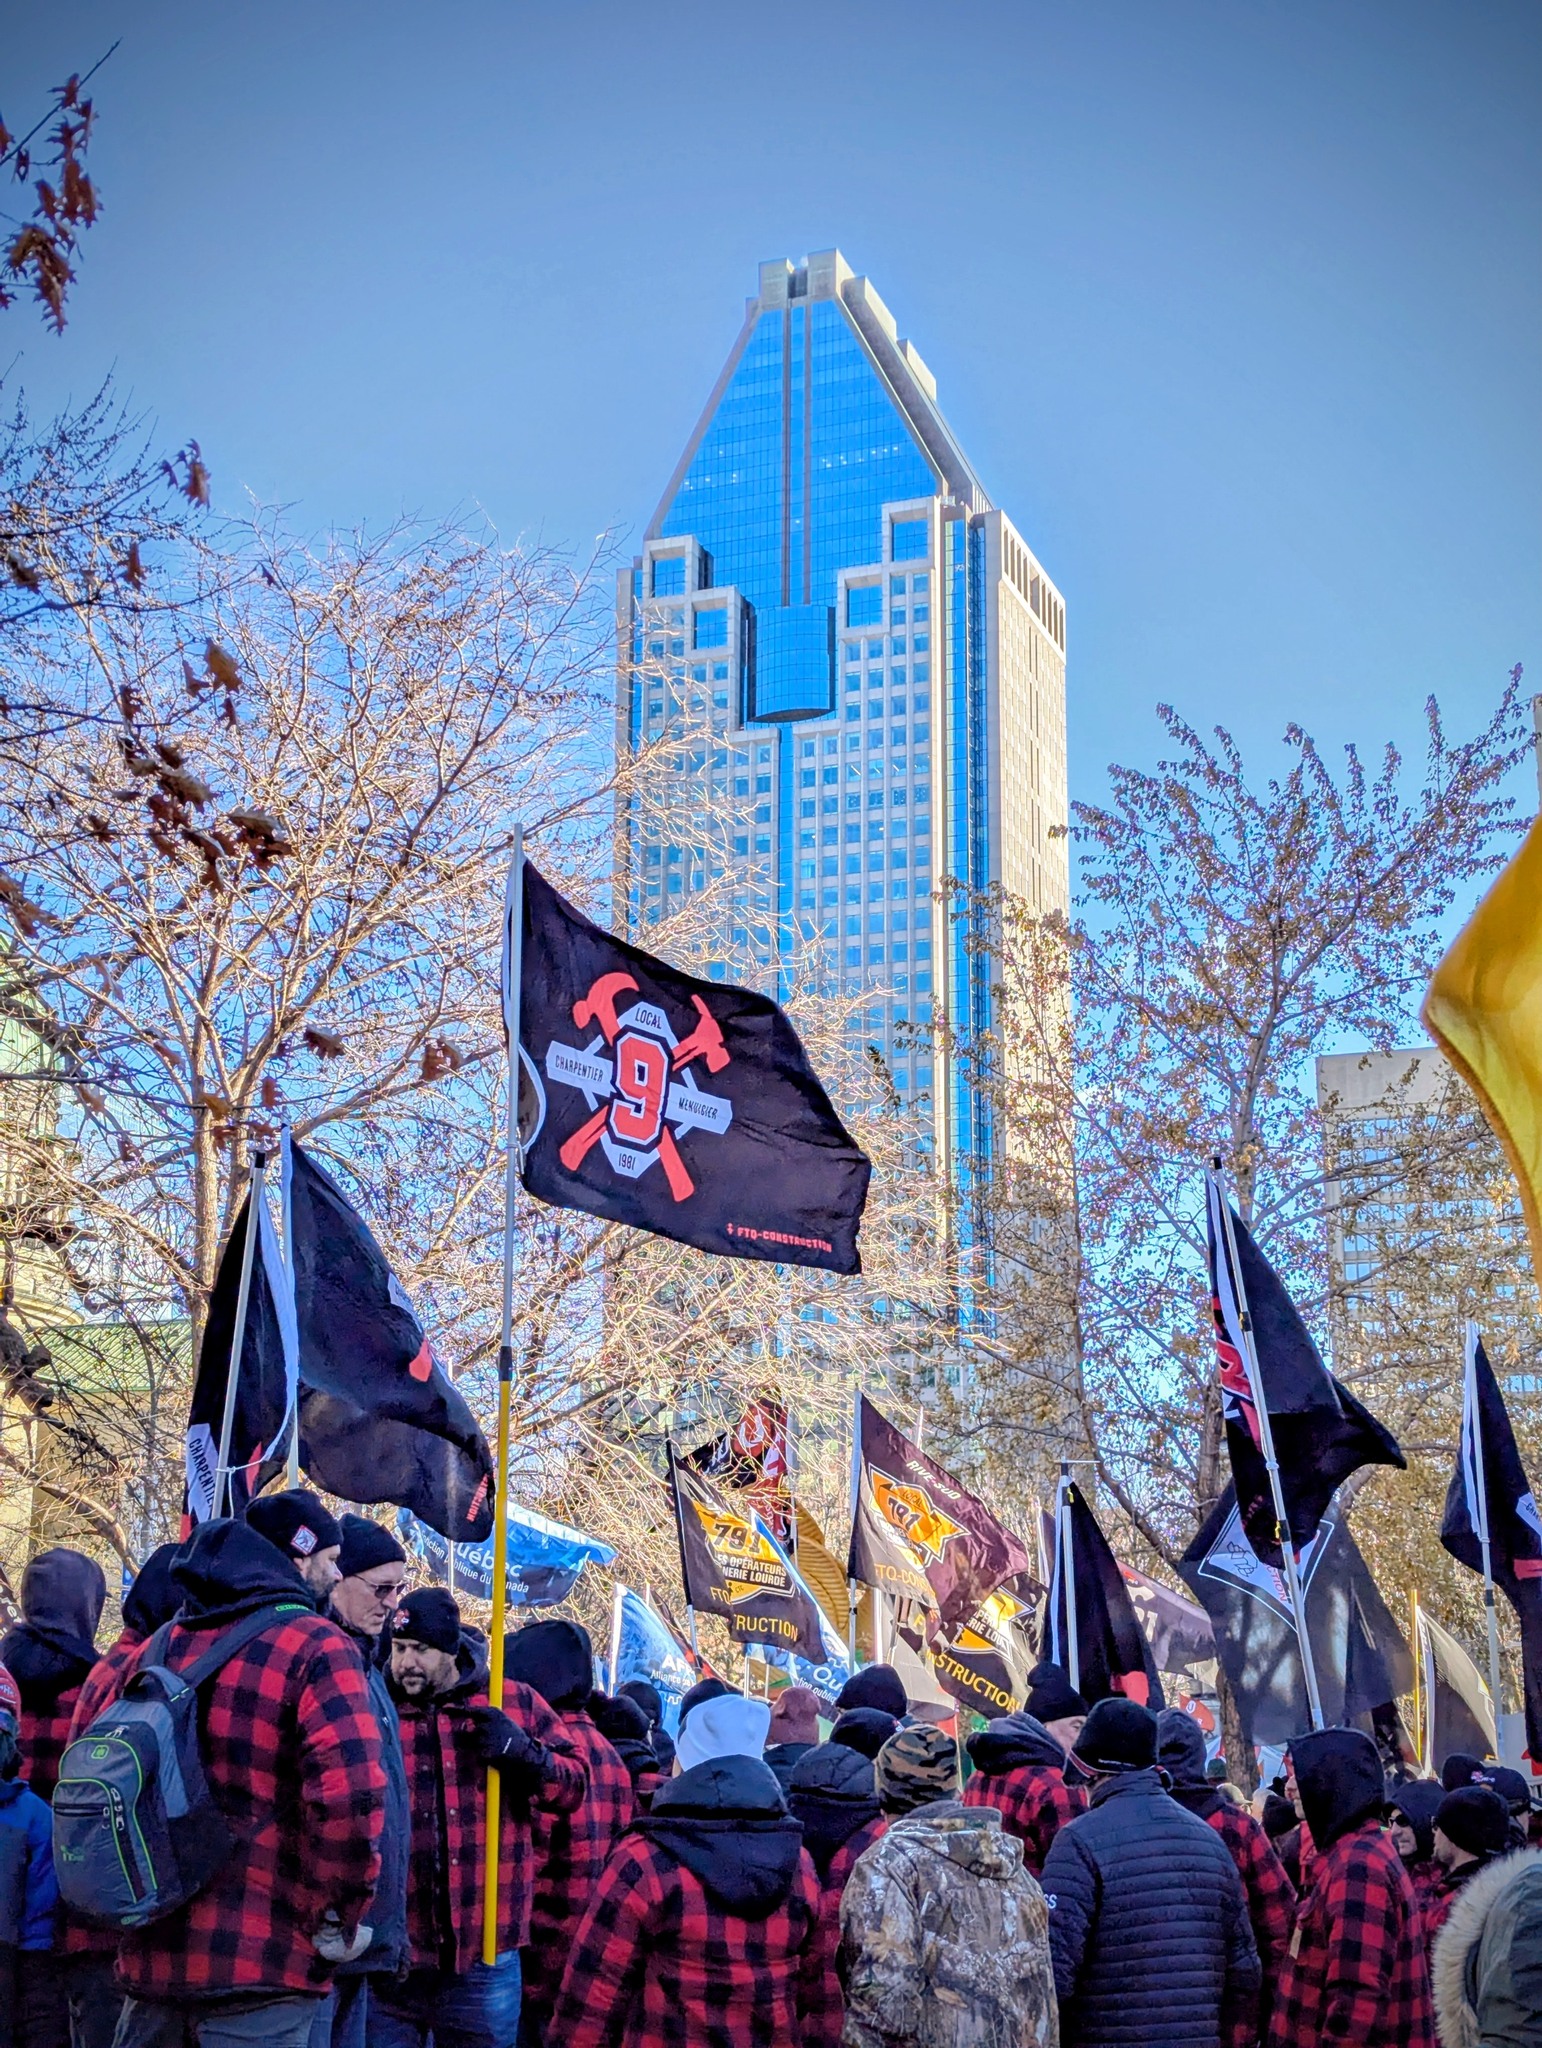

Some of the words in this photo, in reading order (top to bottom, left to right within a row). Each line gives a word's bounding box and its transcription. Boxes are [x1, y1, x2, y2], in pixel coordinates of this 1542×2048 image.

[634, 1007, 662, 1030] LOCAL
[555, 1054, 604, 1083] CHARPENTIER
[609, 1031, 668, 1146] 9
[678, 1097, 719, 1120] MENUISIER
[618, 1153, 637, 1171] 1981
[737, 1226, 832, 1254] FTQ-CONSTRUCTION
[906, 1460, 962, 1500] RIVE-SUD
[901, 1490, 923, 1507] LOCAL
[713, 1522, 762, 1554] 791
[749, 1571, 786, 1588] LOURDE
[734, 1613, 798, 1642] RUCTION
